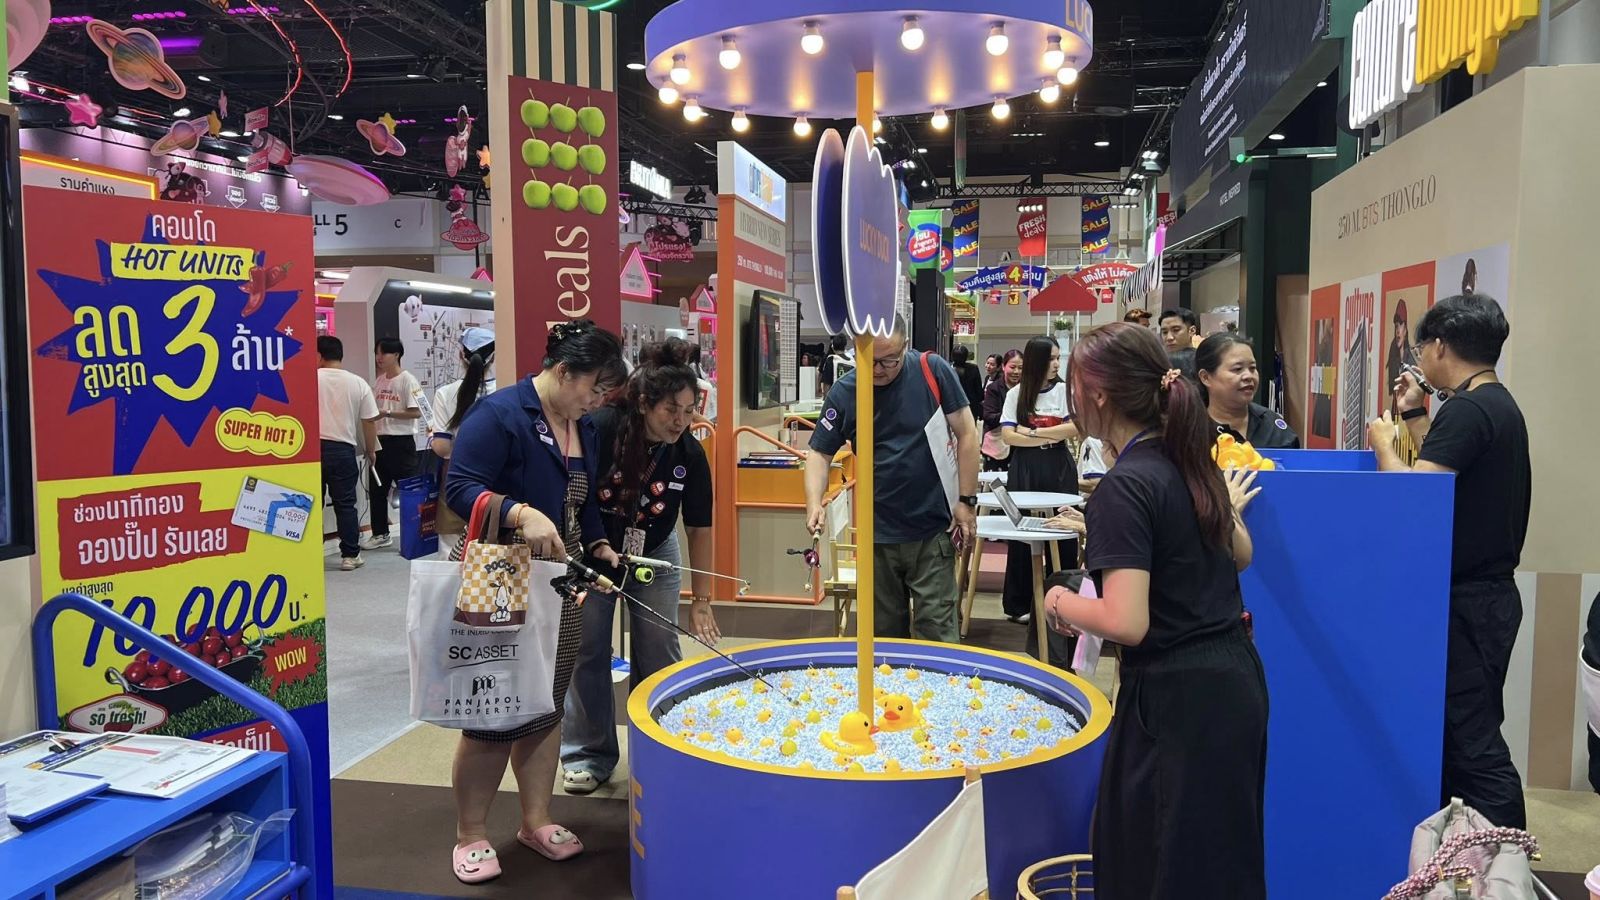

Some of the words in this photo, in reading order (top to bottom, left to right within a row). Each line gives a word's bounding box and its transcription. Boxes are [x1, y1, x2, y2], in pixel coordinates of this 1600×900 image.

[60, 177, 115, 195] รามคำแหง
[953, 200, 978, 216] SALE
[1083, 195, 1110, 212] SALE
[1338, 213, 1351, 240] 250
[1362, 201, 1379, 230] BTS
[1381, 174, 1436, 222] THONGLO
[152, 210, 216, 242] คอนโด
[335, 213, 348, 236] 5
[394, 219, 402, 229] C
[953, 221, 978, 237] SALE
[1019, 214, 1046, 232] FRESH
[1024, 223, 1045, 238] deals
[1082, 216, 1109, 233] SALE
[953, 241, 978, 257] SALE
[1082, 238, 1109, 254] SALE
[121, 245, 176, 272] HOT
[179, 250, 244, 276] UNITS
[544, 225, 591, 330] eals
[1009, 266, 1021, 282] 4
[73, 305, 142, 358] ลด
[152, 284, 220, 402] 3
[83, 361, 147, 398] สูงสุด
[224, 418, 262, 440] SUPER
[74, 493, 184, 523] ช่วงนาทีทอง
[164, 525, 228, 556] รับเลย
[285, 529, 300, 540] VISA
[82, 573, 288, 668] 10000
[274, 646, 307, 673] WOW
[449, 645, 472, 660] SC
[474, 644, 519, 660] ASSET
[444, 705, 521, 716] PROPERTY
[445, 695, 521, 708] PANJAPOL
[89, 712, 106, 726] so
[110, 710, 147, 725] fresh!
